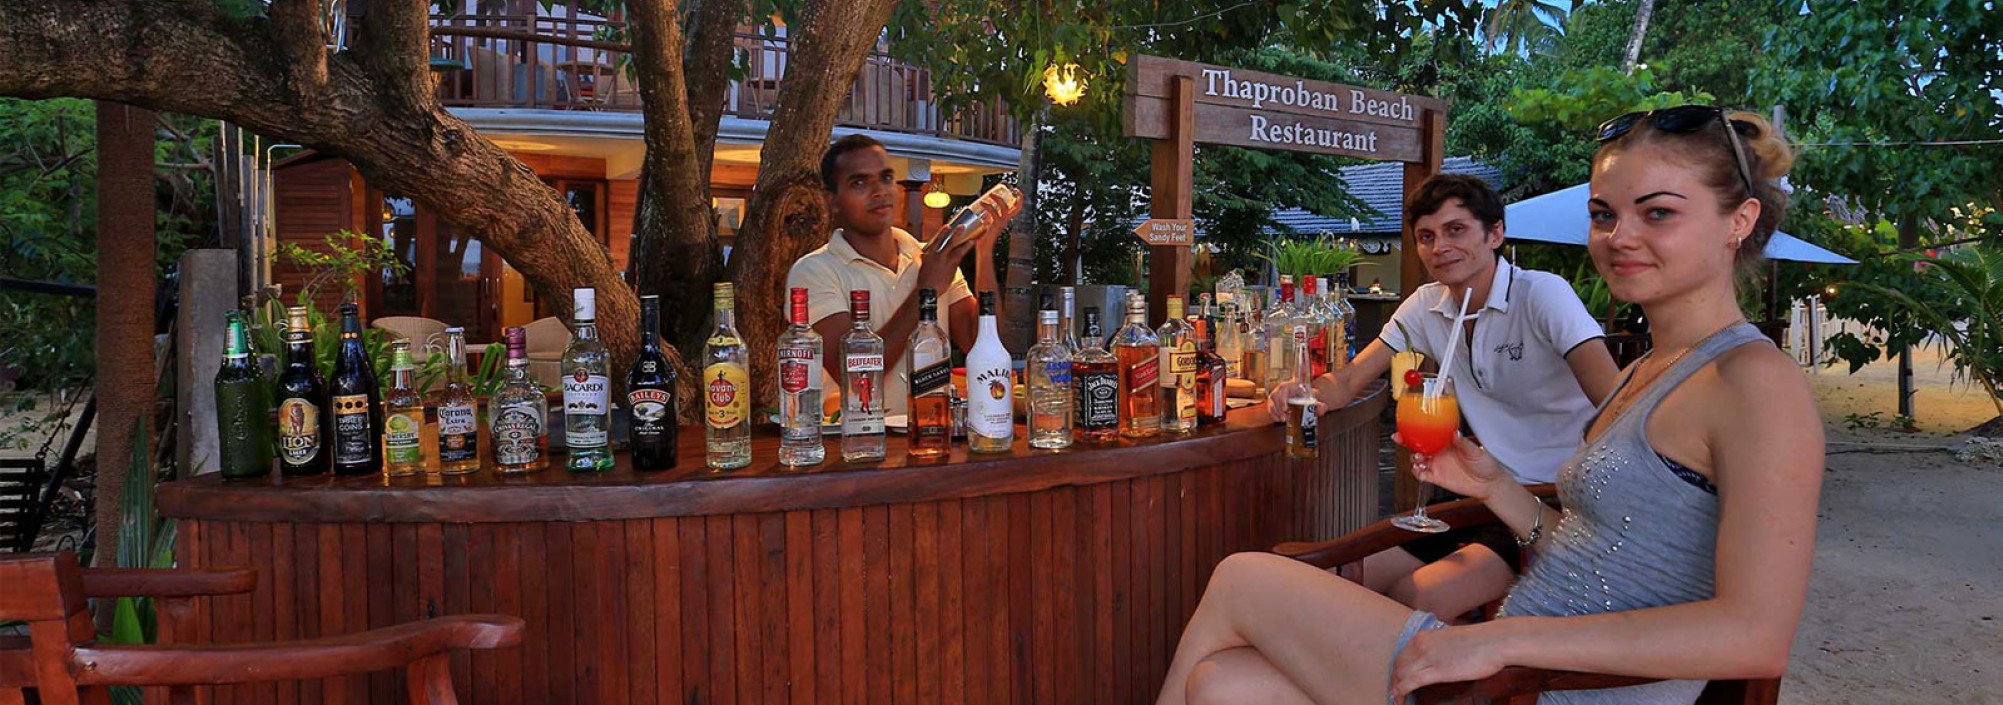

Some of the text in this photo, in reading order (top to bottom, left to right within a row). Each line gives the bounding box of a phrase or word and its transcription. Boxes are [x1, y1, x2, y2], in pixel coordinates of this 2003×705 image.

[1202, 69, 1414, 121] Thaproban Beach
[1249, 115, 1378, 152] Restaurant
[1152, 223, 1187, 231] Wash Your
[1149, 233, 1186, 243] Sandy Feet
[848, 357, 883, 368] BEEFEATER
[564, 383, 603, 392] BACARDI
[631, 391, 666, 402] BAILEYS
[712, 392, 731, 402] Club
[440, 408, 473, 419] Corona
